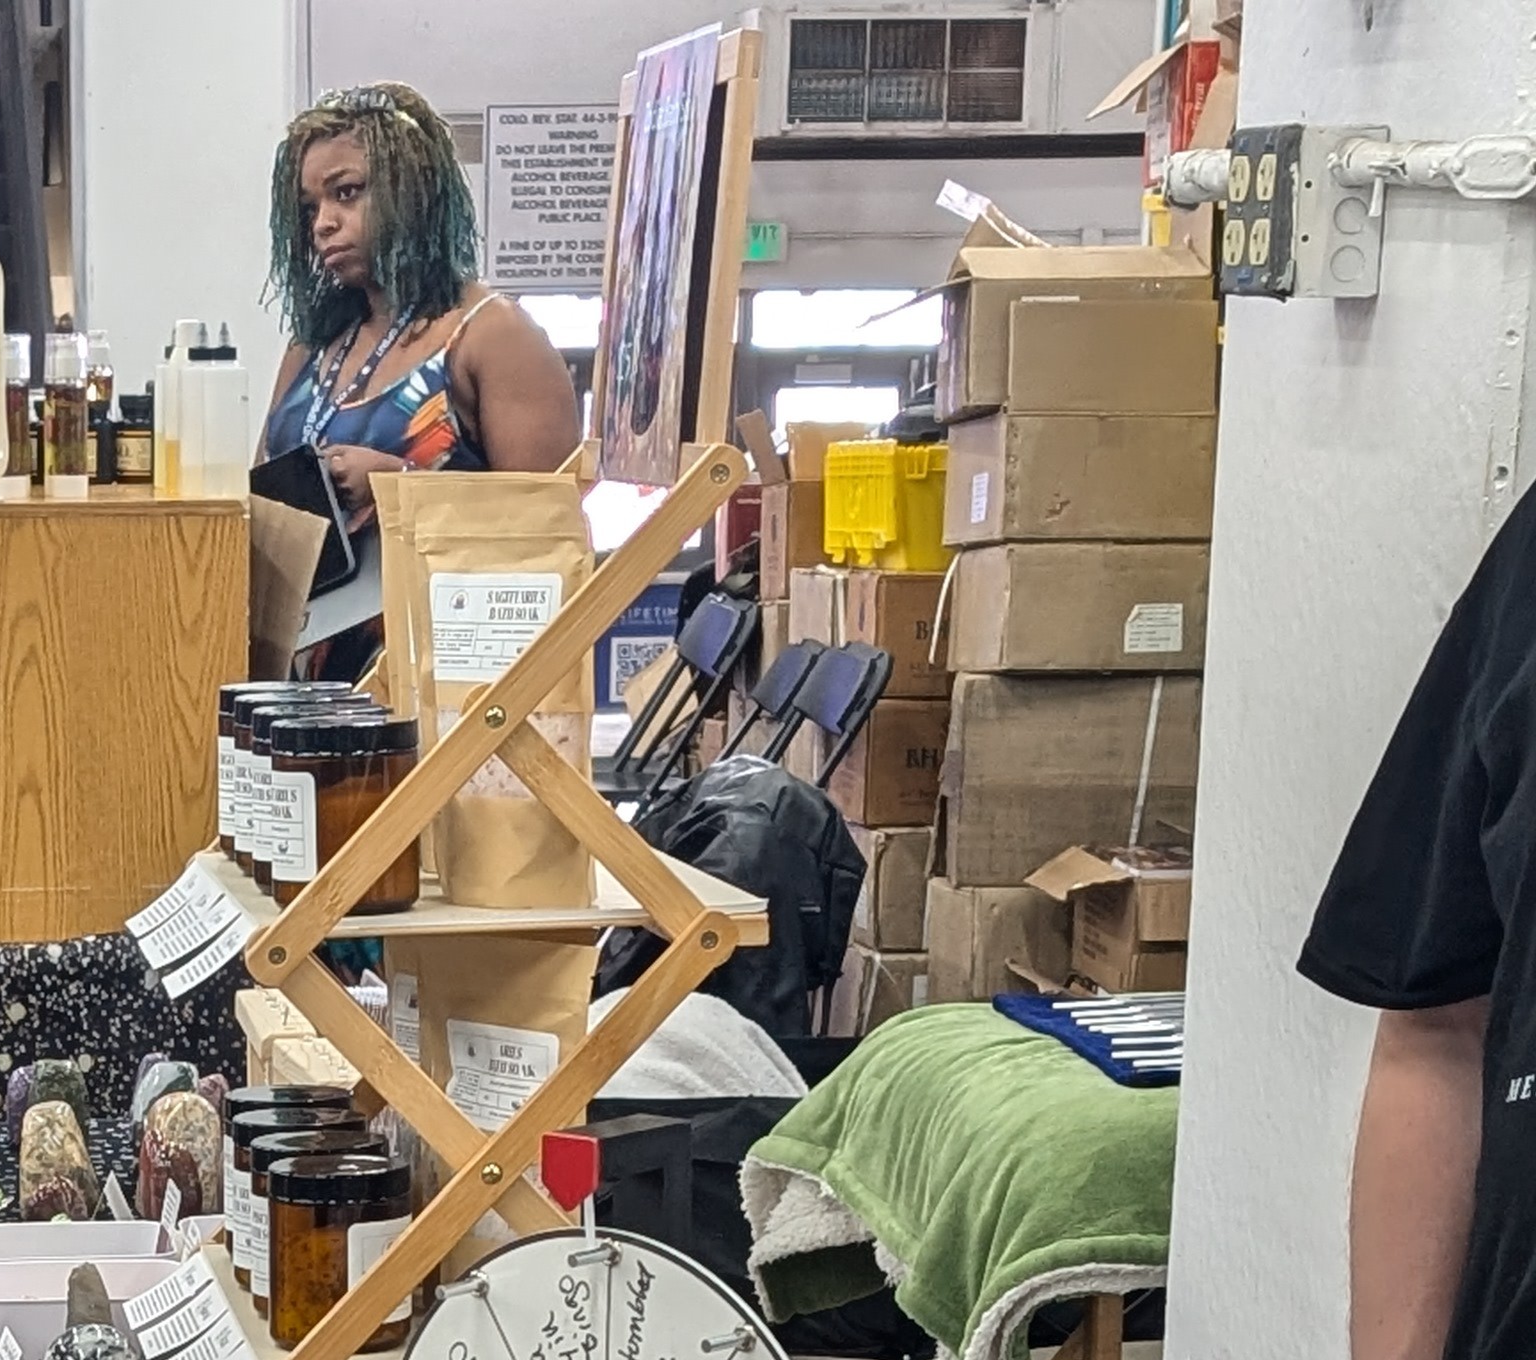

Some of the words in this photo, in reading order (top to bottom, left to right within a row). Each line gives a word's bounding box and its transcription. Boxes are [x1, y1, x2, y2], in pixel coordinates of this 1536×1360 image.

[548, 130, 599, 140] WARNING
[496, 144, 512, 155] DO
[514, 144, 535, 155] NOT
[538, 144, 565, 155] LEAVE
[569, 144, 586, 154] THE
[501, 158, 522, 169] THIS
[524, 158, 599, 169] ESTABLISHMENT
[511, 172, 557, 182] ALCOHOL
[511, 186, 547, 196] ILLEGAL
[550, 186, 562, 196] TO
[511, 199, 557, 210] ALCOHOL
[538, 213, 570, 223] PUBLIC
[499, 240, 507, 250] A
[509, 240, 529, 250] FINE
[532, 240, 547, 250] OF
[549, 240, 562, 250] UP
[565, 240, 578, 250] TO
[496, 254, 539, 265] IMPOSED
[541, 254, 553, 265] BY
[556, 254, 573, 264] THE
[495, 268, 547, 278] VIOLATION
[550, 268, 564, 278] OF
[567, 268, 587, 278] THIS
